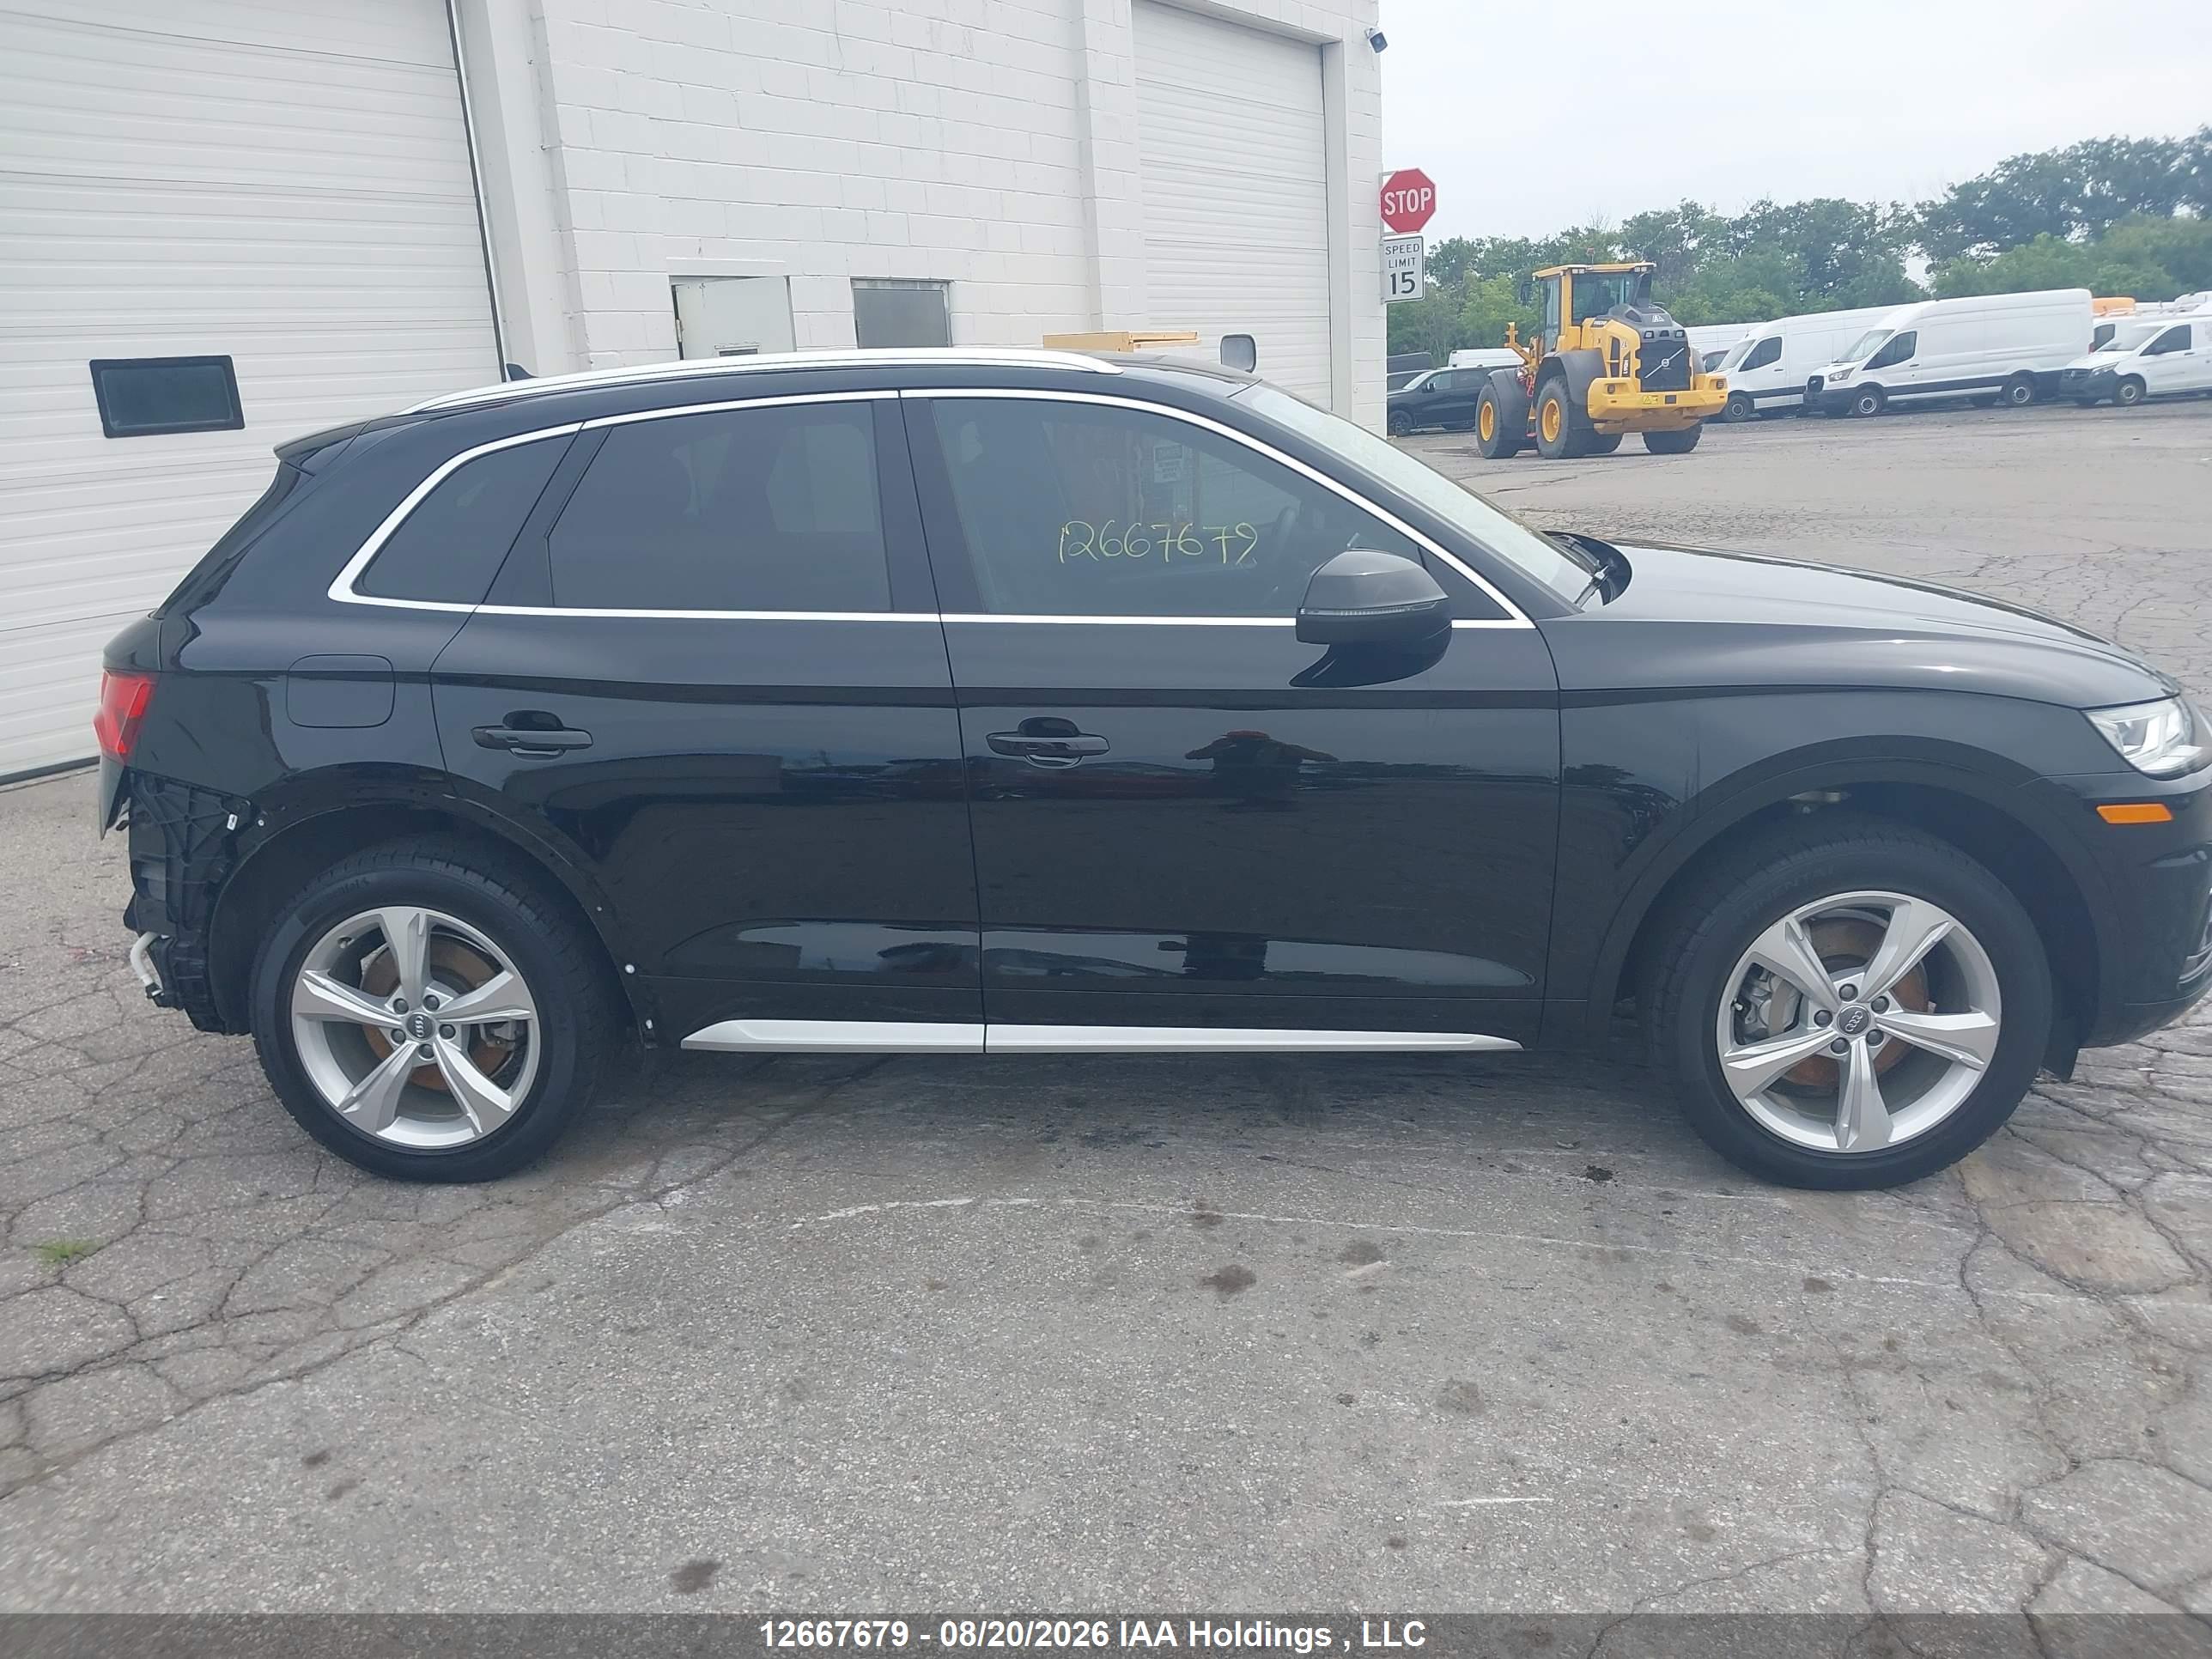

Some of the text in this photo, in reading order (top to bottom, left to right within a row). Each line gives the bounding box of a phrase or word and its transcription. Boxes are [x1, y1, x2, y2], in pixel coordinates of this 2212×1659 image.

[1384, 187, 1431, 216] STOP
[1385, 243, 1420, 255] SPEED
[1389, 257, 1417, 269] LIMIT
[1390, 270, 1416, 295] 15
[1059, 520, 1258, 565] 12667679
